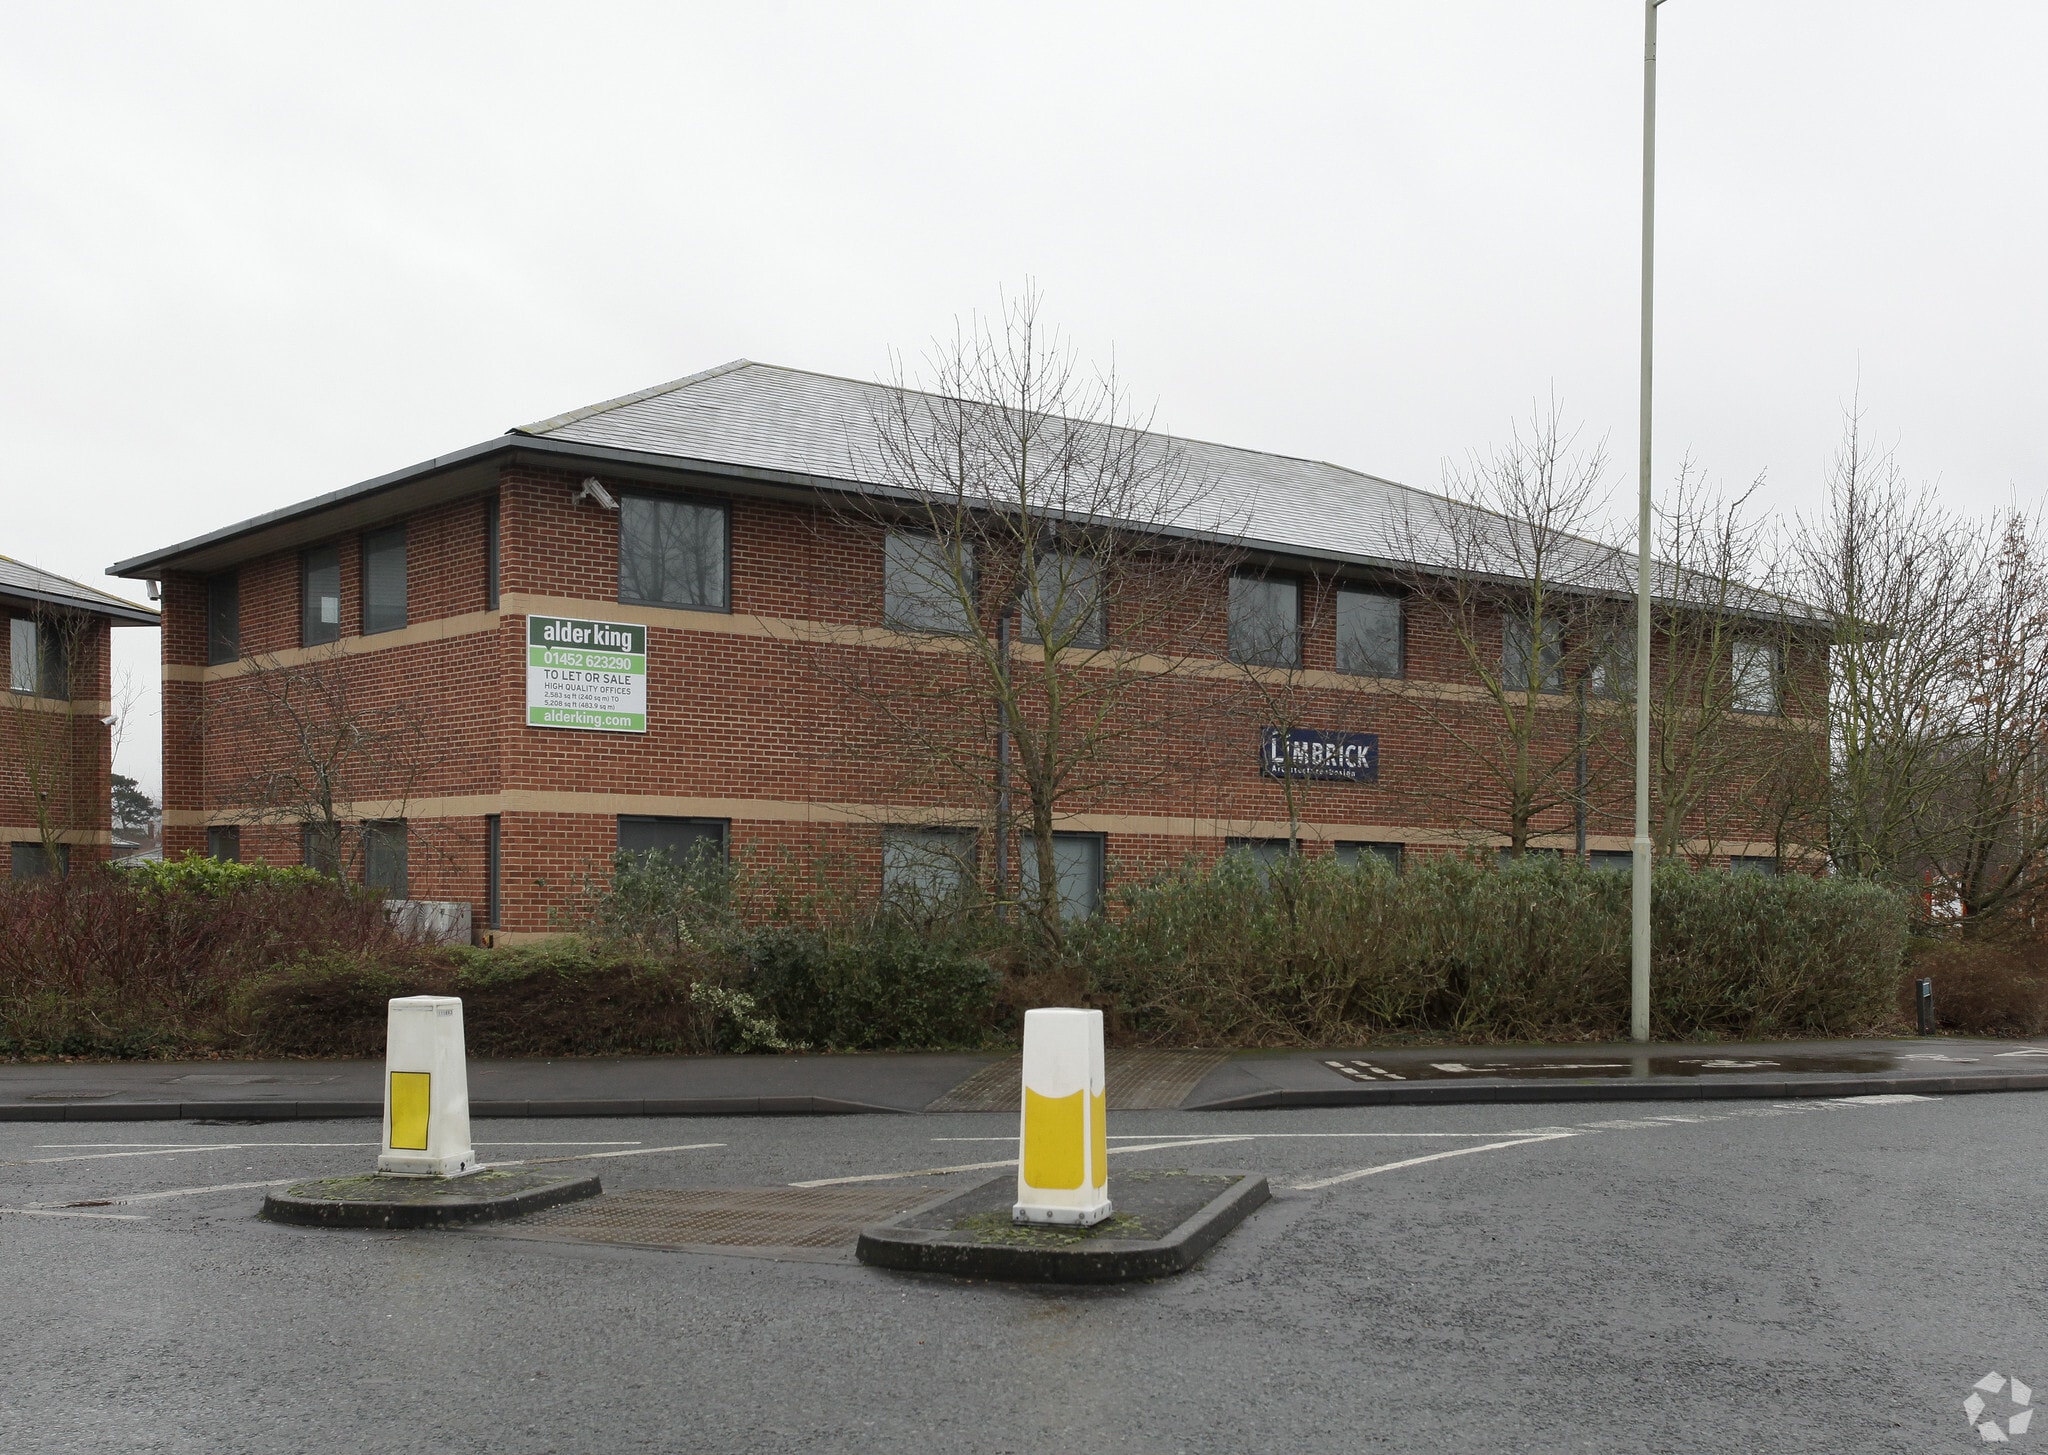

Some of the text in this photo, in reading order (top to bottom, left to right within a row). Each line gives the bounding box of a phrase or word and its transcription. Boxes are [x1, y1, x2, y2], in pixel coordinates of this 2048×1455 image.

[543, 620, 632, 652] alder king
[543, 651, 631, 671] 01452 623290
[544, 669, 631, 685] TO LET OR SALE
[544, 682, 631, 695] HIGH QUALITY OFFICES
[578, 693, 593, 701] (240
[543, 709, 632, 727] alderking.com
